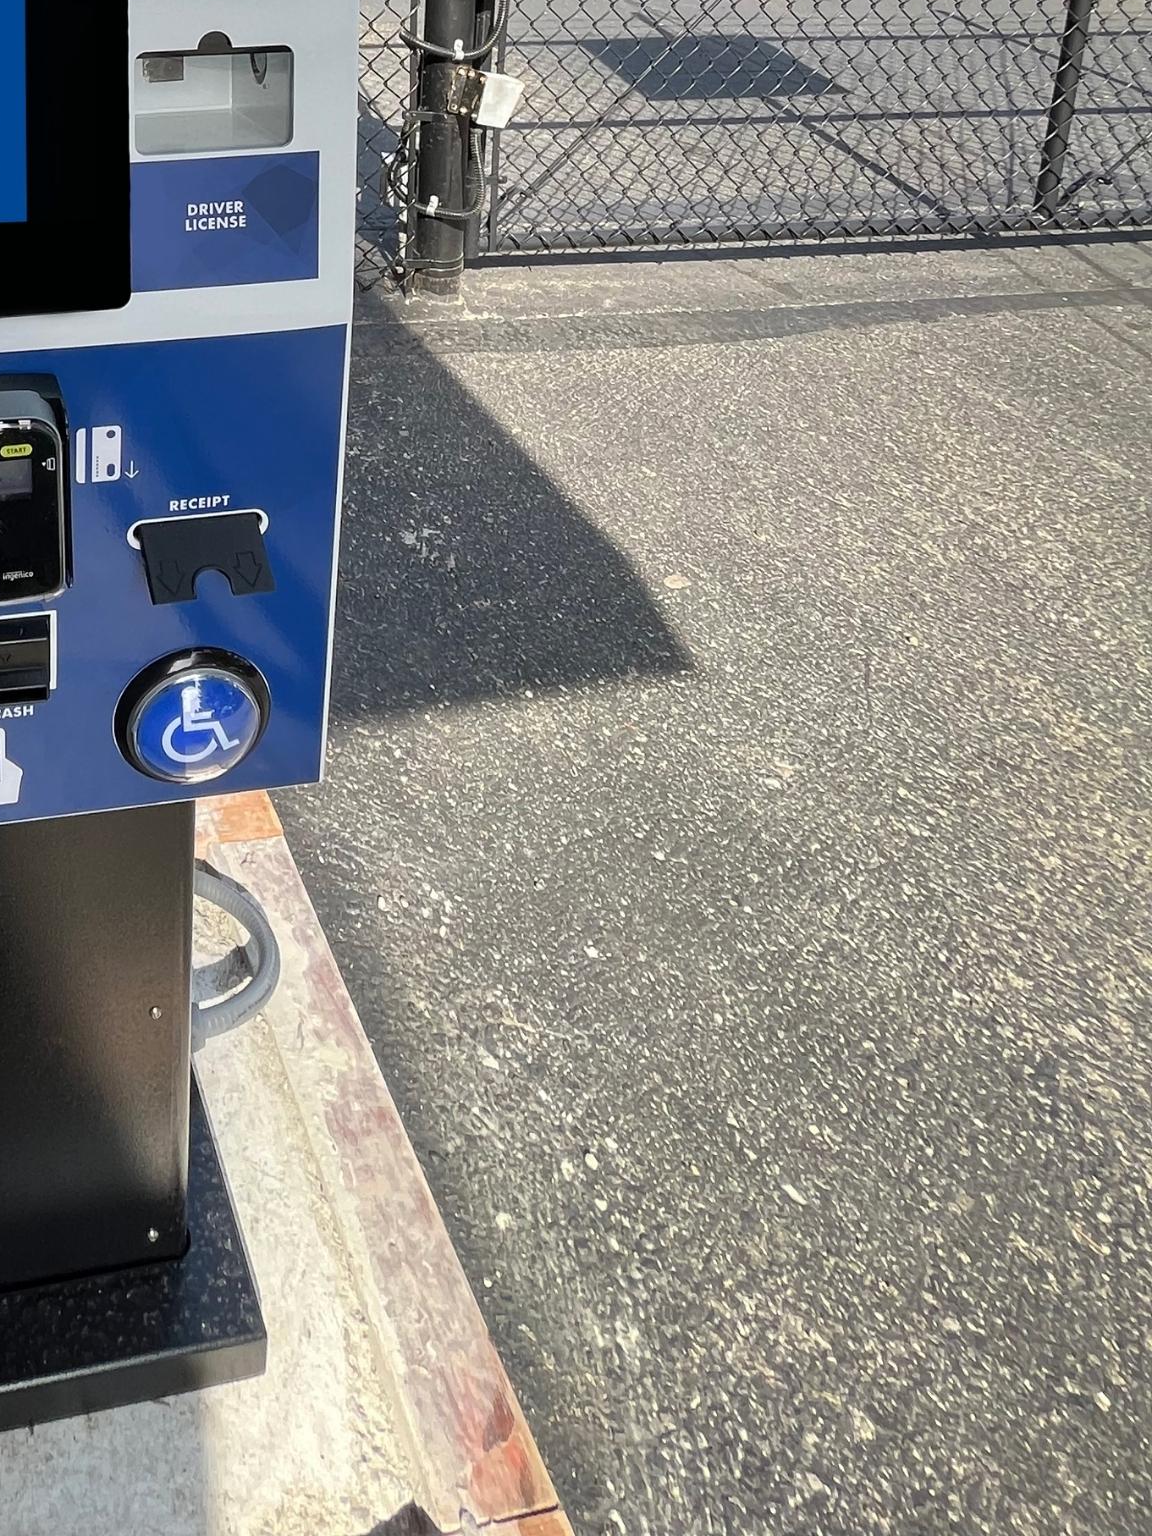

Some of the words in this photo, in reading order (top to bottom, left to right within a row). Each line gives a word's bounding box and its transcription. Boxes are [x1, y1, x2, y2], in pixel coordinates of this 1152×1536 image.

[187, 200, 244, 216] DRIVER
[185, 215, 247, 232] LICENSE
[169, 495, 230, 511] RECEIPT
